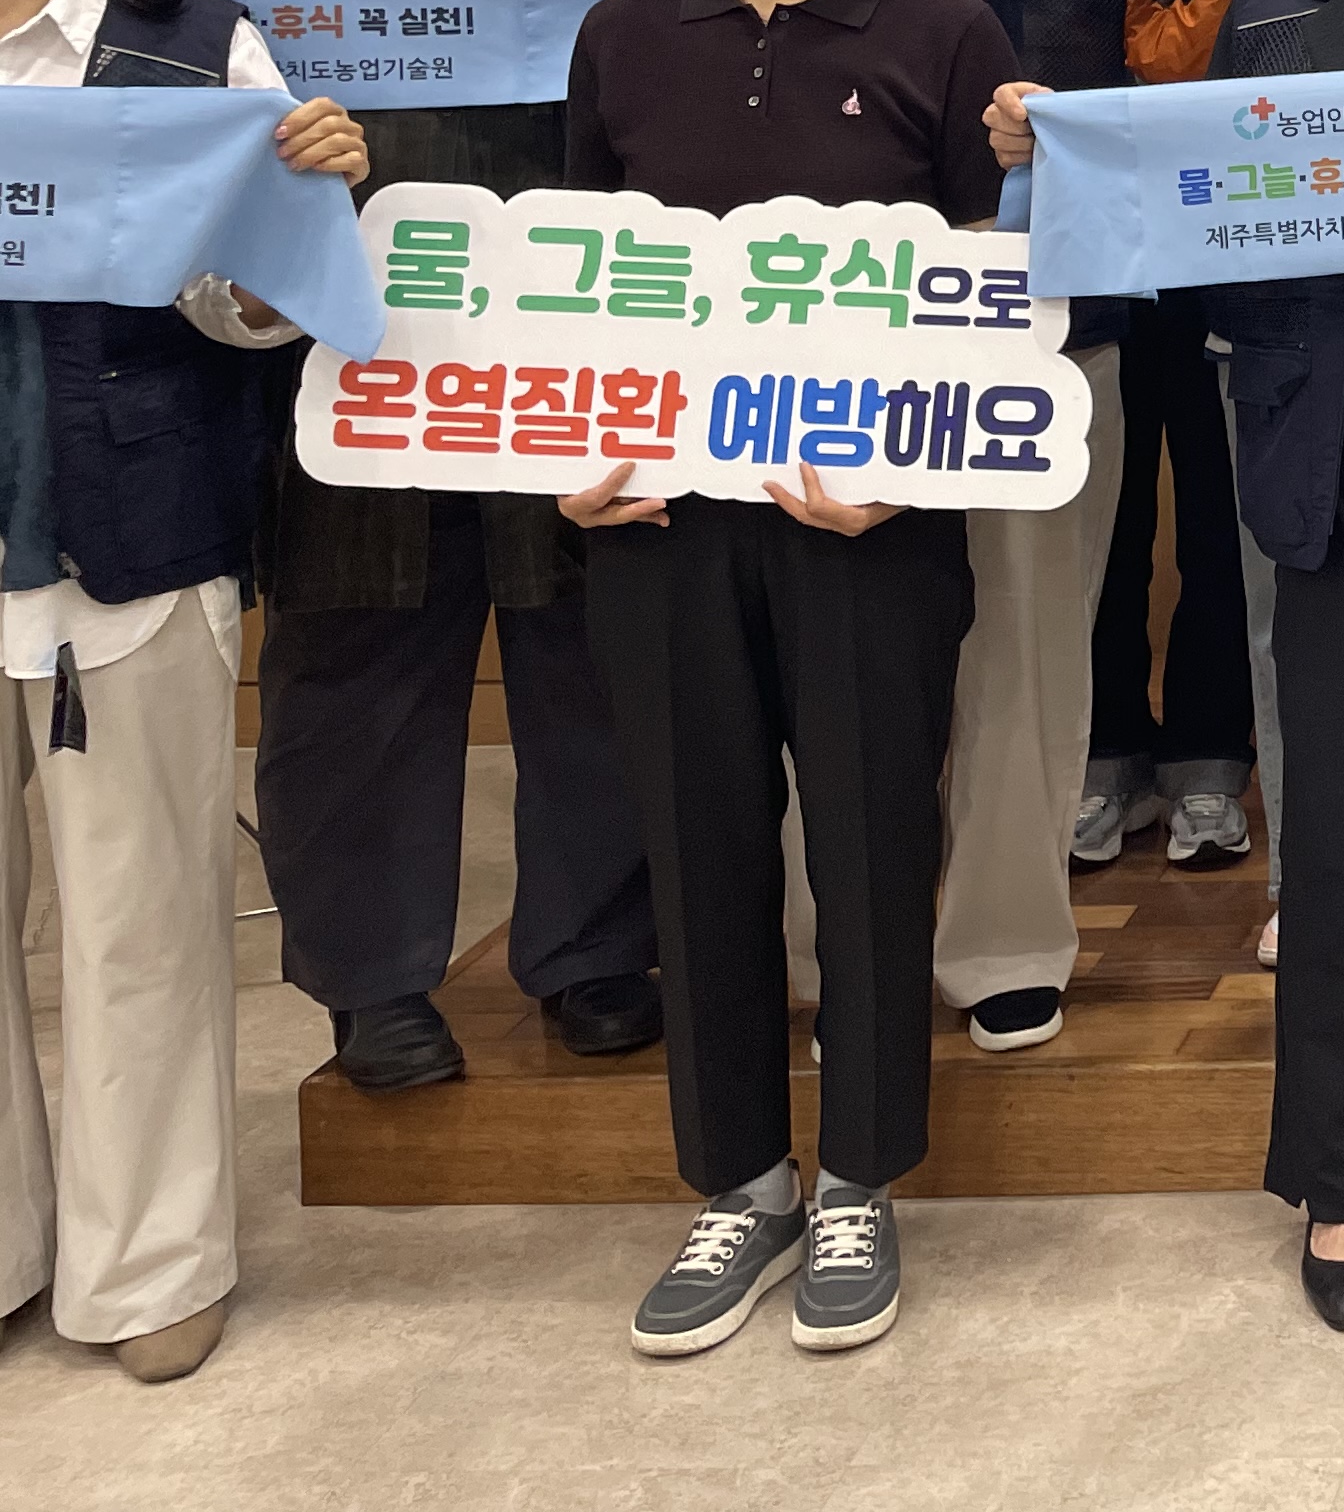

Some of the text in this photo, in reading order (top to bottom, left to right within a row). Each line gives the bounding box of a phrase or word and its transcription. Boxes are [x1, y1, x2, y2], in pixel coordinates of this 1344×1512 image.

[358, 8, 389, 36] 꼭
[398, 7, 474, 35] 실천!
[278, 56, 454, 82] 치도농업기술원
[0, 183, 55, 216] 천!
[384, 219, 1031, 329] 물, 그늘, 휴식으로
[332, 358, 1053, 472] 온열질환 예방해요
